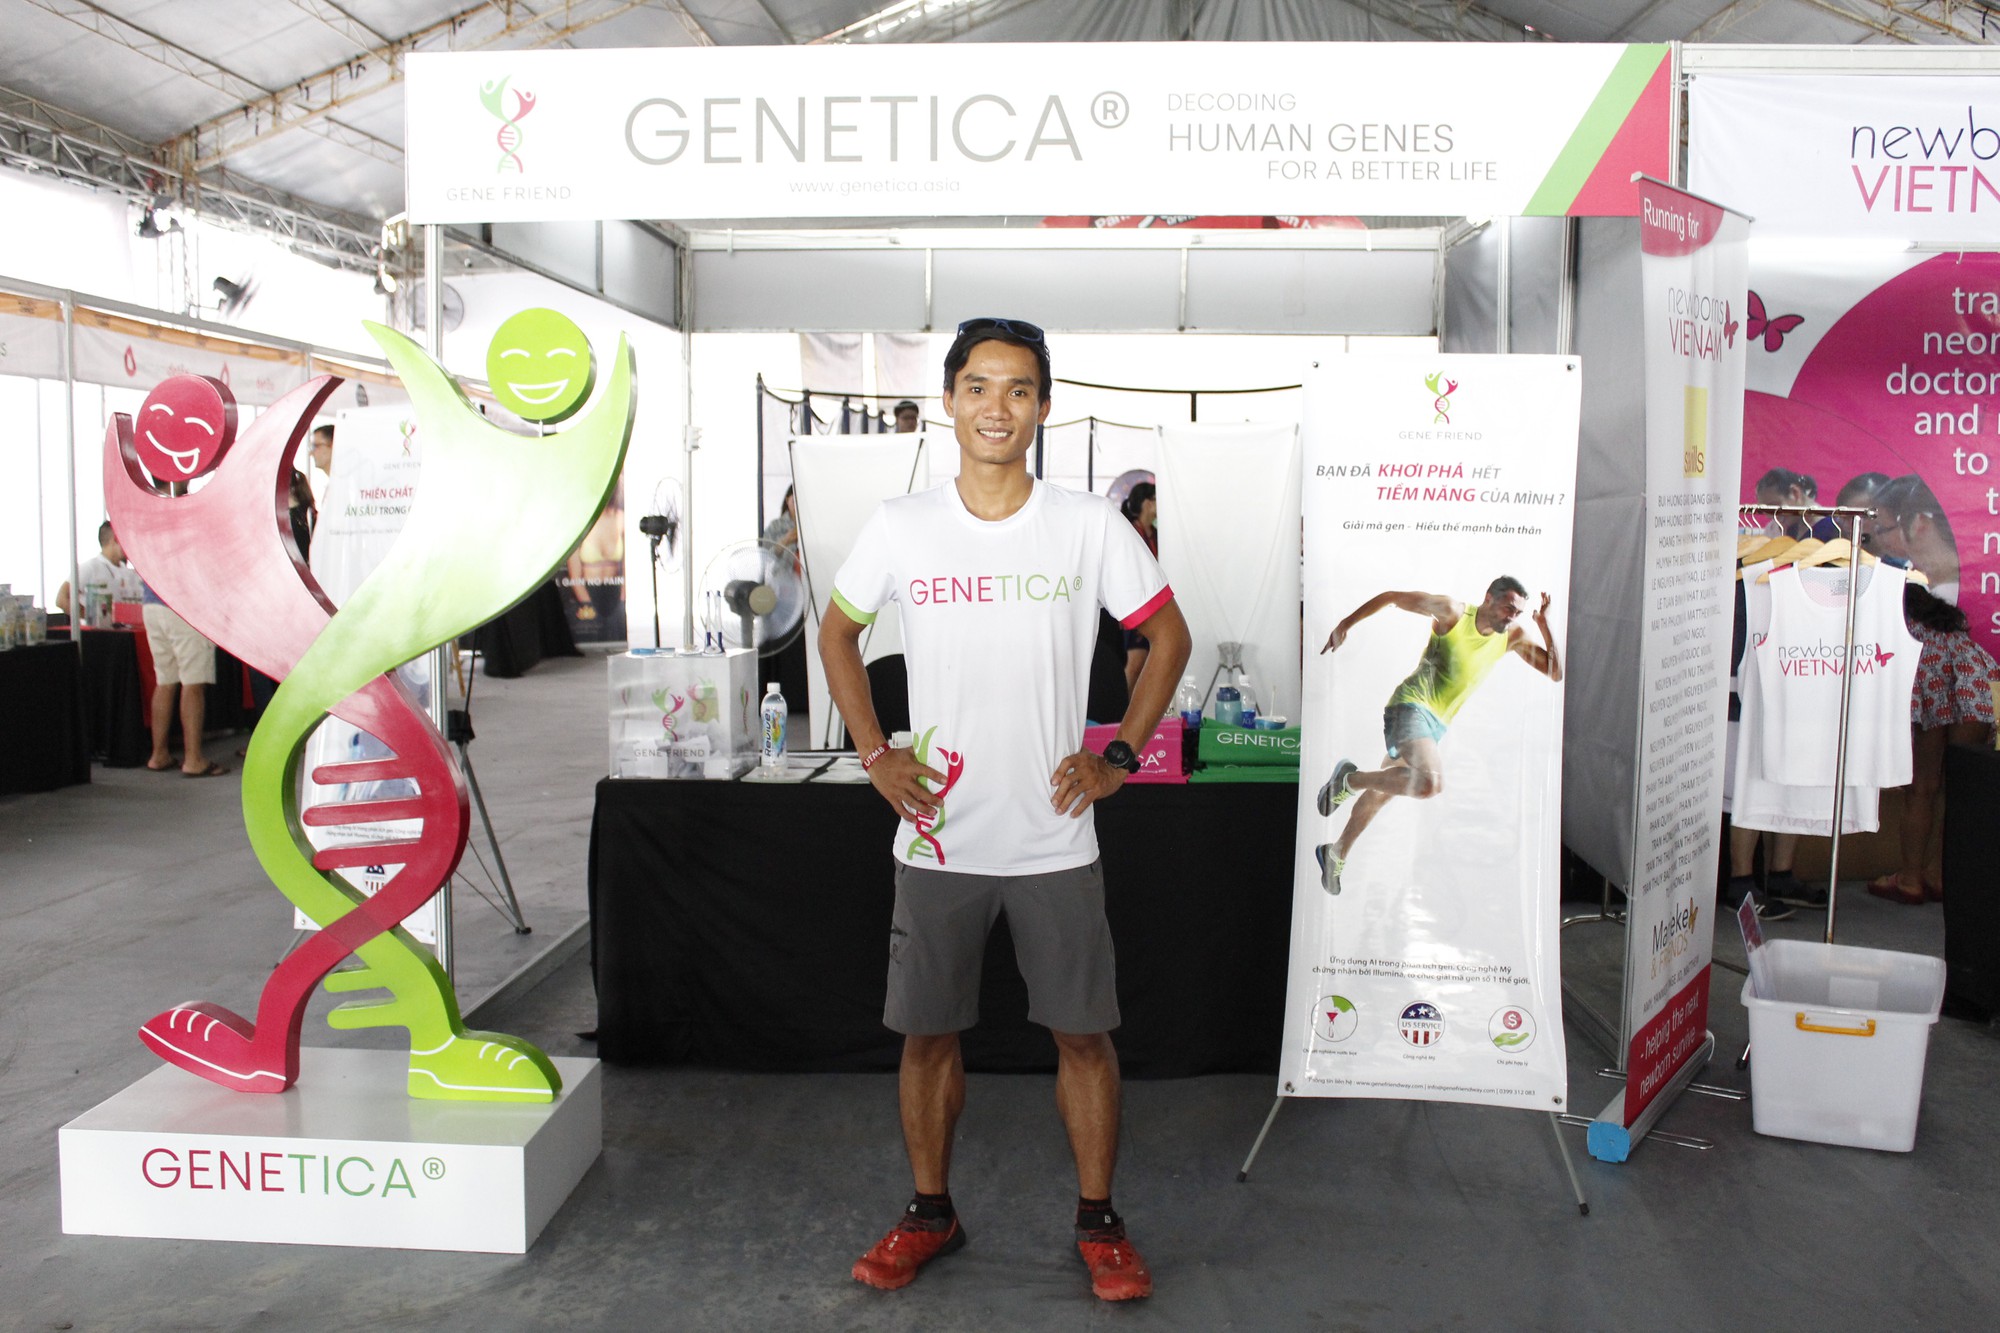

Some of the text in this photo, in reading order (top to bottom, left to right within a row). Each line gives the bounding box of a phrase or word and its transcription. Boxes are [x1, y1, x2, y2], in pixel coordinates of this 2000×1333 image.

[1168, 93, 1297, 112] DECODING
[1169, 123, 1455, 153] HUMAN GENES
[1268, 160, 1498, 181] FOR A BETTER LIFE
[447, 186, 572, 201] GENE FRIEND
[788, 177, 961, 197] www.genetica.asia
[1643, 197, 1699, 242] Running for
[1914, 404, 1979, 435] and
[1398, 431, 1482, 441] GENE FRIEND
[1316, 465, 1347, 481] BẠN
[1350, 463, 1371, 477] ĐÃ
[1378, 463, 1423, 478] KHƠI
[1427, 462, 1464, 479] PHÁ
[1953, 447, 1989, 476] to
[1423, 484, 1476, 502] NĂNG
[1480, 488, 1510, 503] CỦA
[1513, 490, 1555, 505] MÌNH
[1558, 493, 1565, 505] ?
[1343, 520, 1364, 530] Giải
[1366, 521, 1382, 530] mã
[1385, 523, 1405, 532] gen
[1416, 520, 1440, 531] Hiểu
[1442, 521, 1460, 532] thế
[1461, 524, 1492, 535] mạnh
[1495, 524, 1515, 535] bản
[1517, 525, 1542, 535] thân
[603, 576, 625, 585] PAIN
[1778, 638, 1874, 659] newbons
[633, 748, 705, 758] GENE FRIEND
[863, 746, 885, 768] UTMB
[1378, 960, 1400, 969] trong
[1500, 966, 1512, 975] Mỹ
[1499, 975, 1512, 984] thế
[1645, 1019, 1670, 1059] helping
[1672, 1007, 1684, 1031] the
[1684, 988, 1699, 1019] next
[1672, 1026, 1696, 1063] survive
